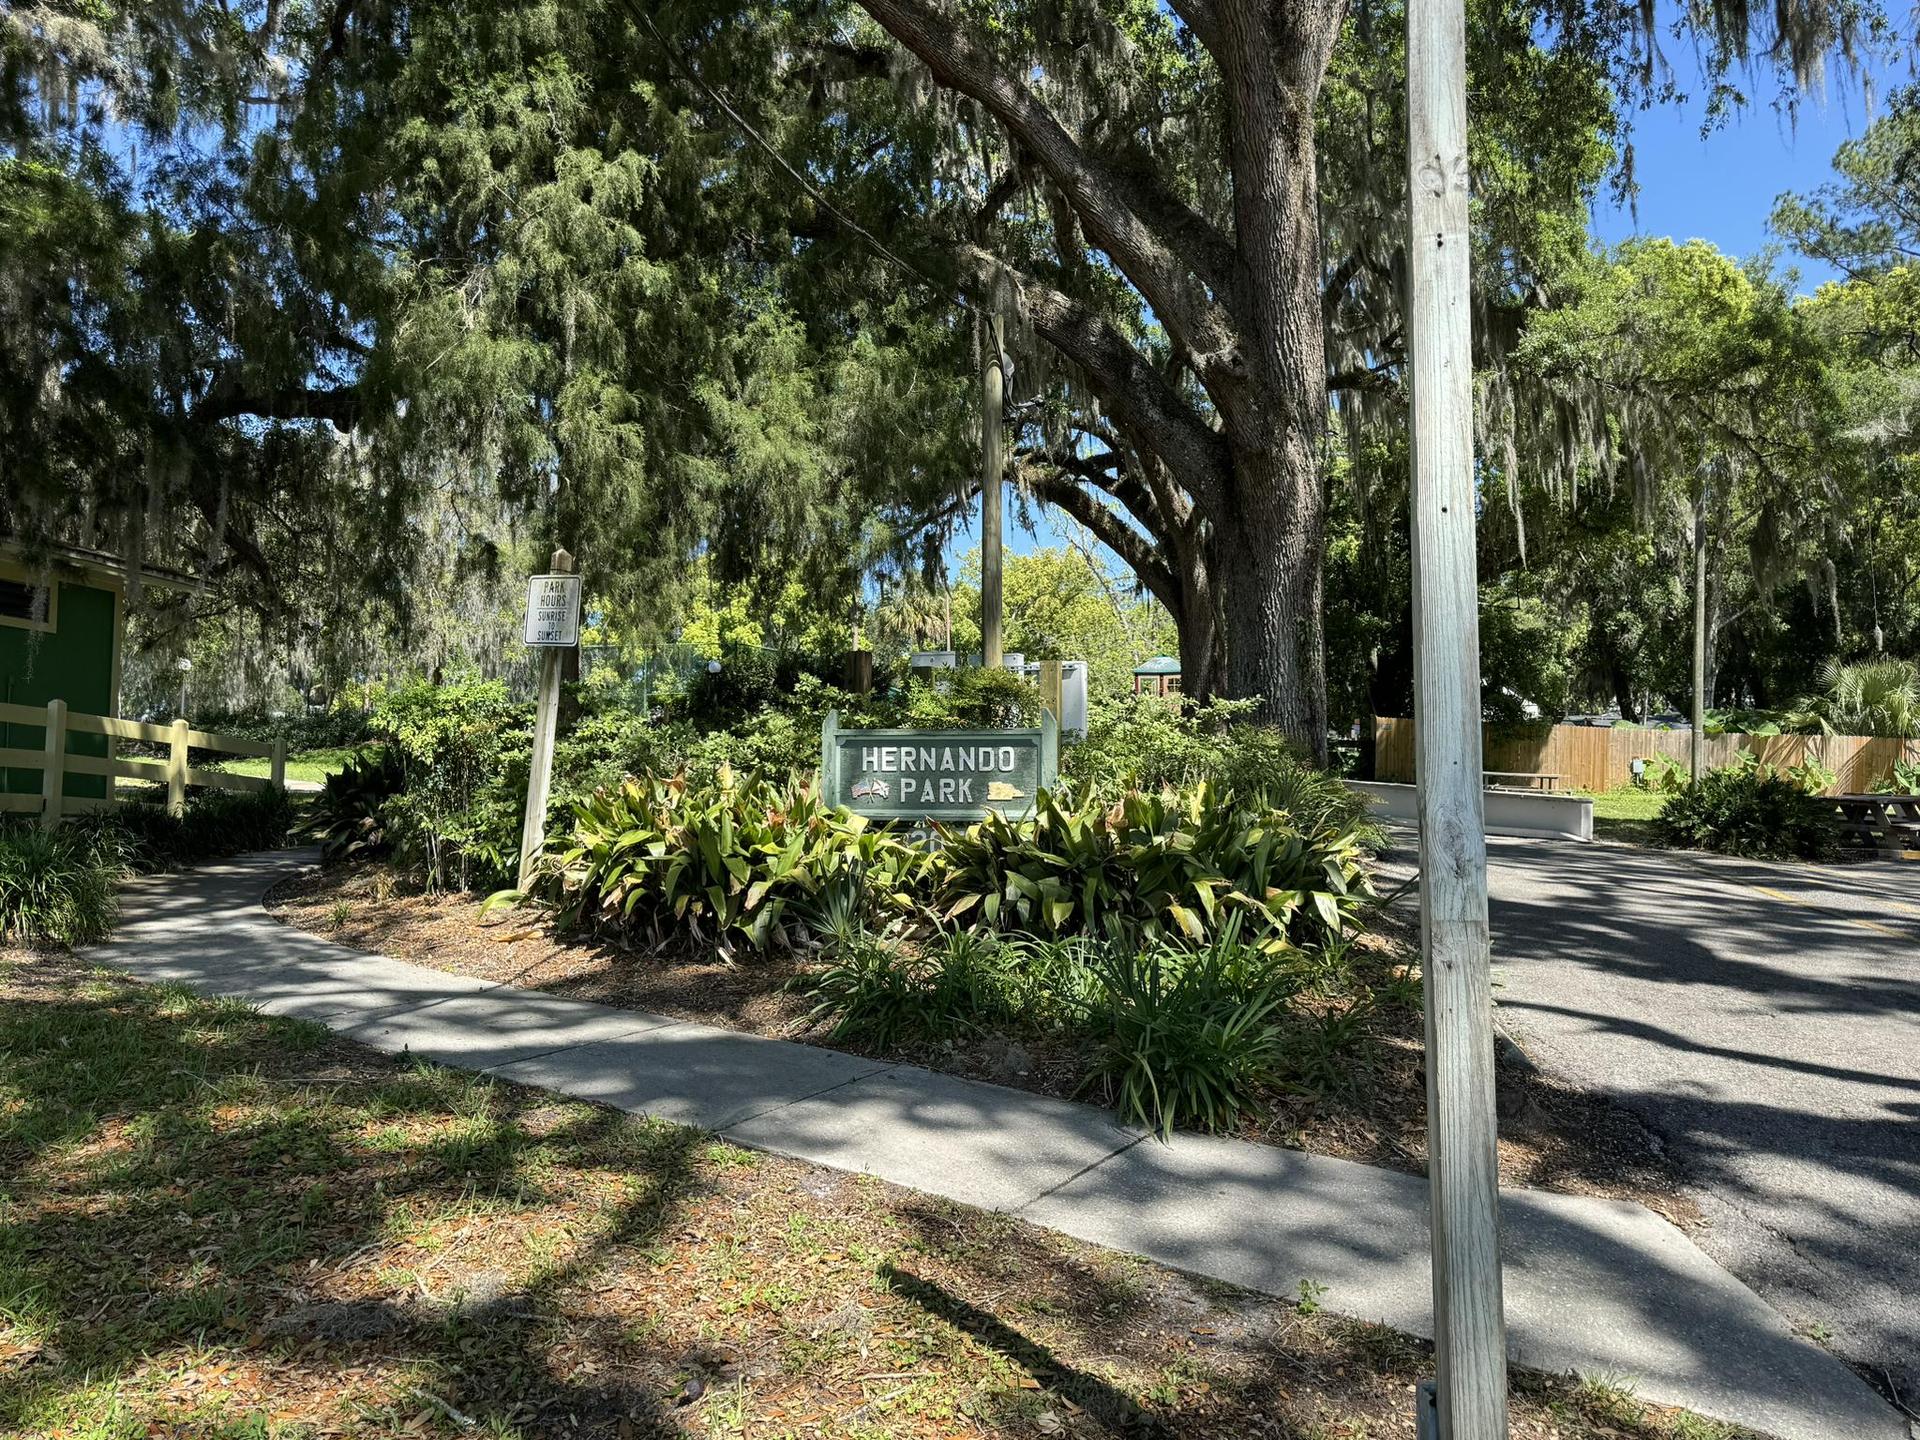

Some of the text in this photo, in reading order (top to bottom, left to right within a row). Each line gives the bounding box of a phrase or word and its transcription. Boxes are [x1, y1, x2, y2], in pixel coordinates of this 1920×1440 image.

[544, 581, 566, 593] PARK
[540, 594, 566, 607] HOURS
[538, 611, 566, 622] SUNRISE
[548, 622, 556, 630] TO
[537, 631, 562, 641] SUNSET
[862, 746, 1016, 772] HERNANDO
[900, 778, 973, 803] PARK
